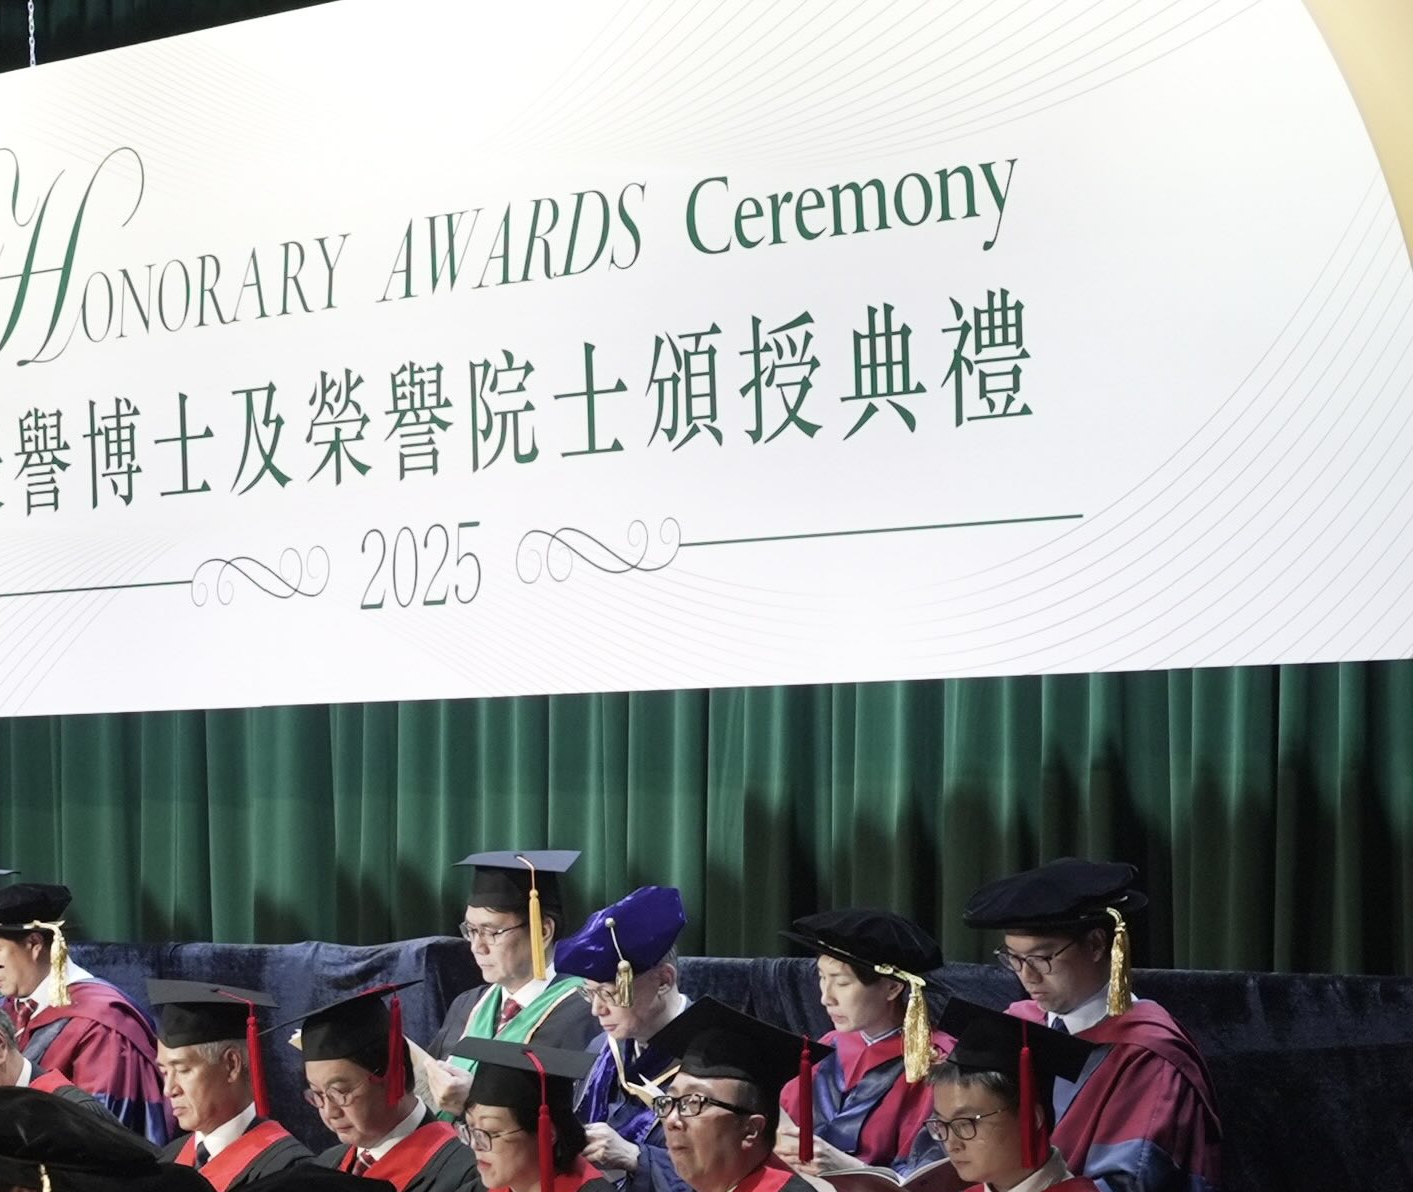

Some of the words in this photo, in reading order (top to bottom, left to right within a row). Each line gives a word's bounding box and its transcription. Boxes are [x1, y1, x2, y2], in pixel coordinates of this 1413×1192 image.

[376, 180, 648, 304] AWARDS
[684, 157, 1018, 255] Ceremony
[360, 521, 482, 611] 2025
